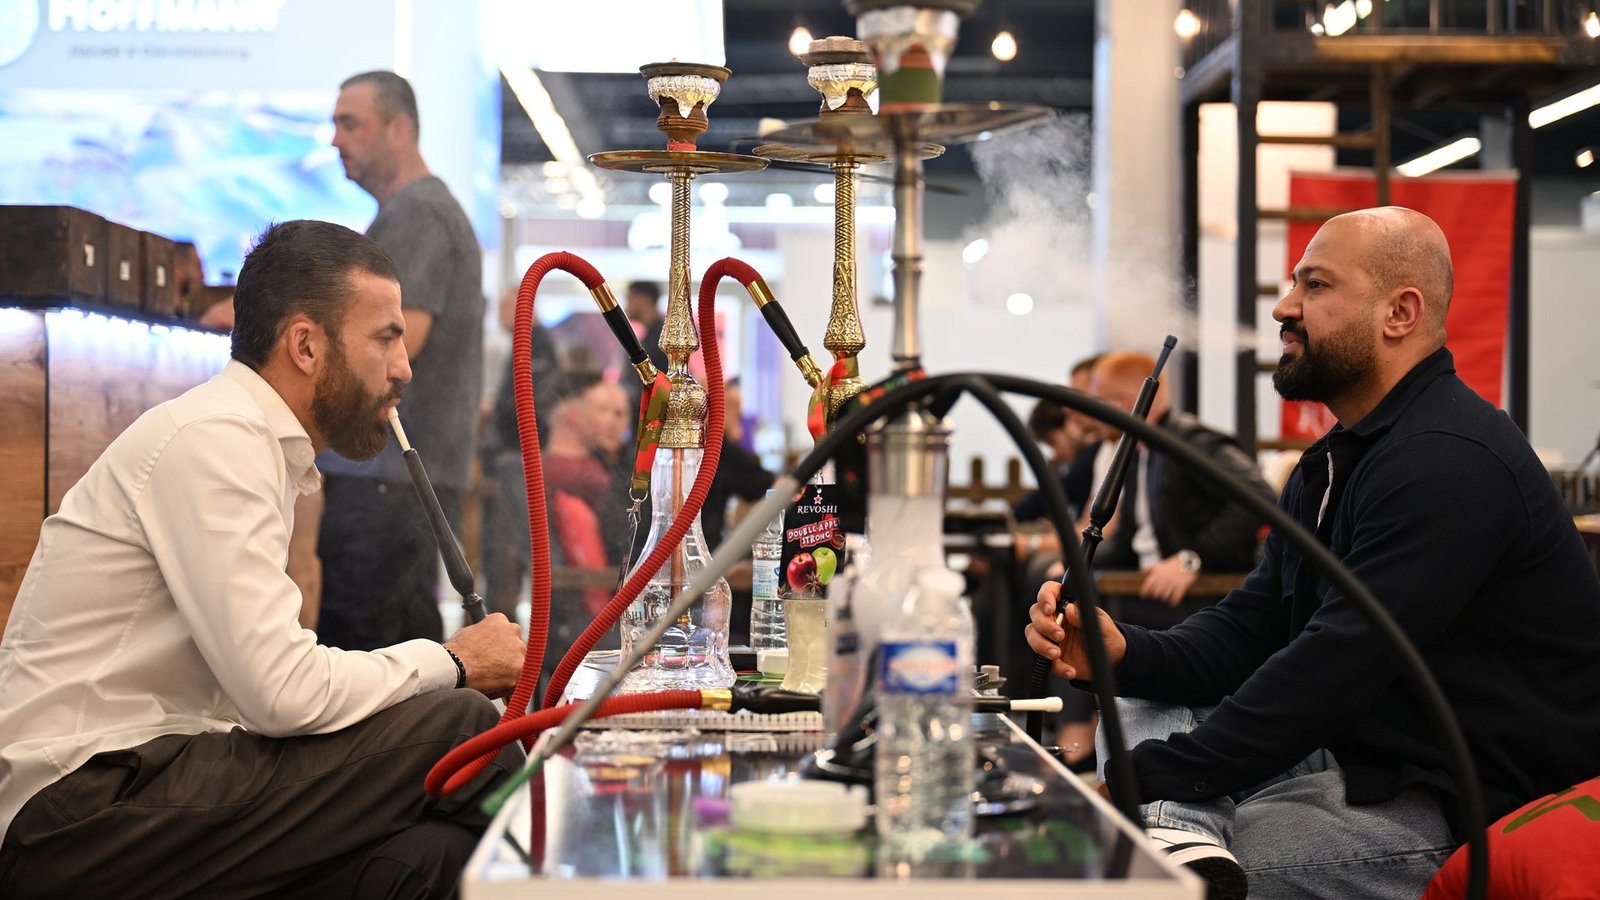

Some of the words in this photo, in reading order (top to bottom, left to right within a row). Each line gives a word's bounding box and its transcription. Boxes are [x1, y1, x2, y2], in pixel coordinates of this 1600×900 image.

[797, 505, 838, 515] REVOSHI
[788, 525, 817, 539] DOUBLE
[818, 519, 841, 532] APPL
[802, 531, 831, 545] STRONG
